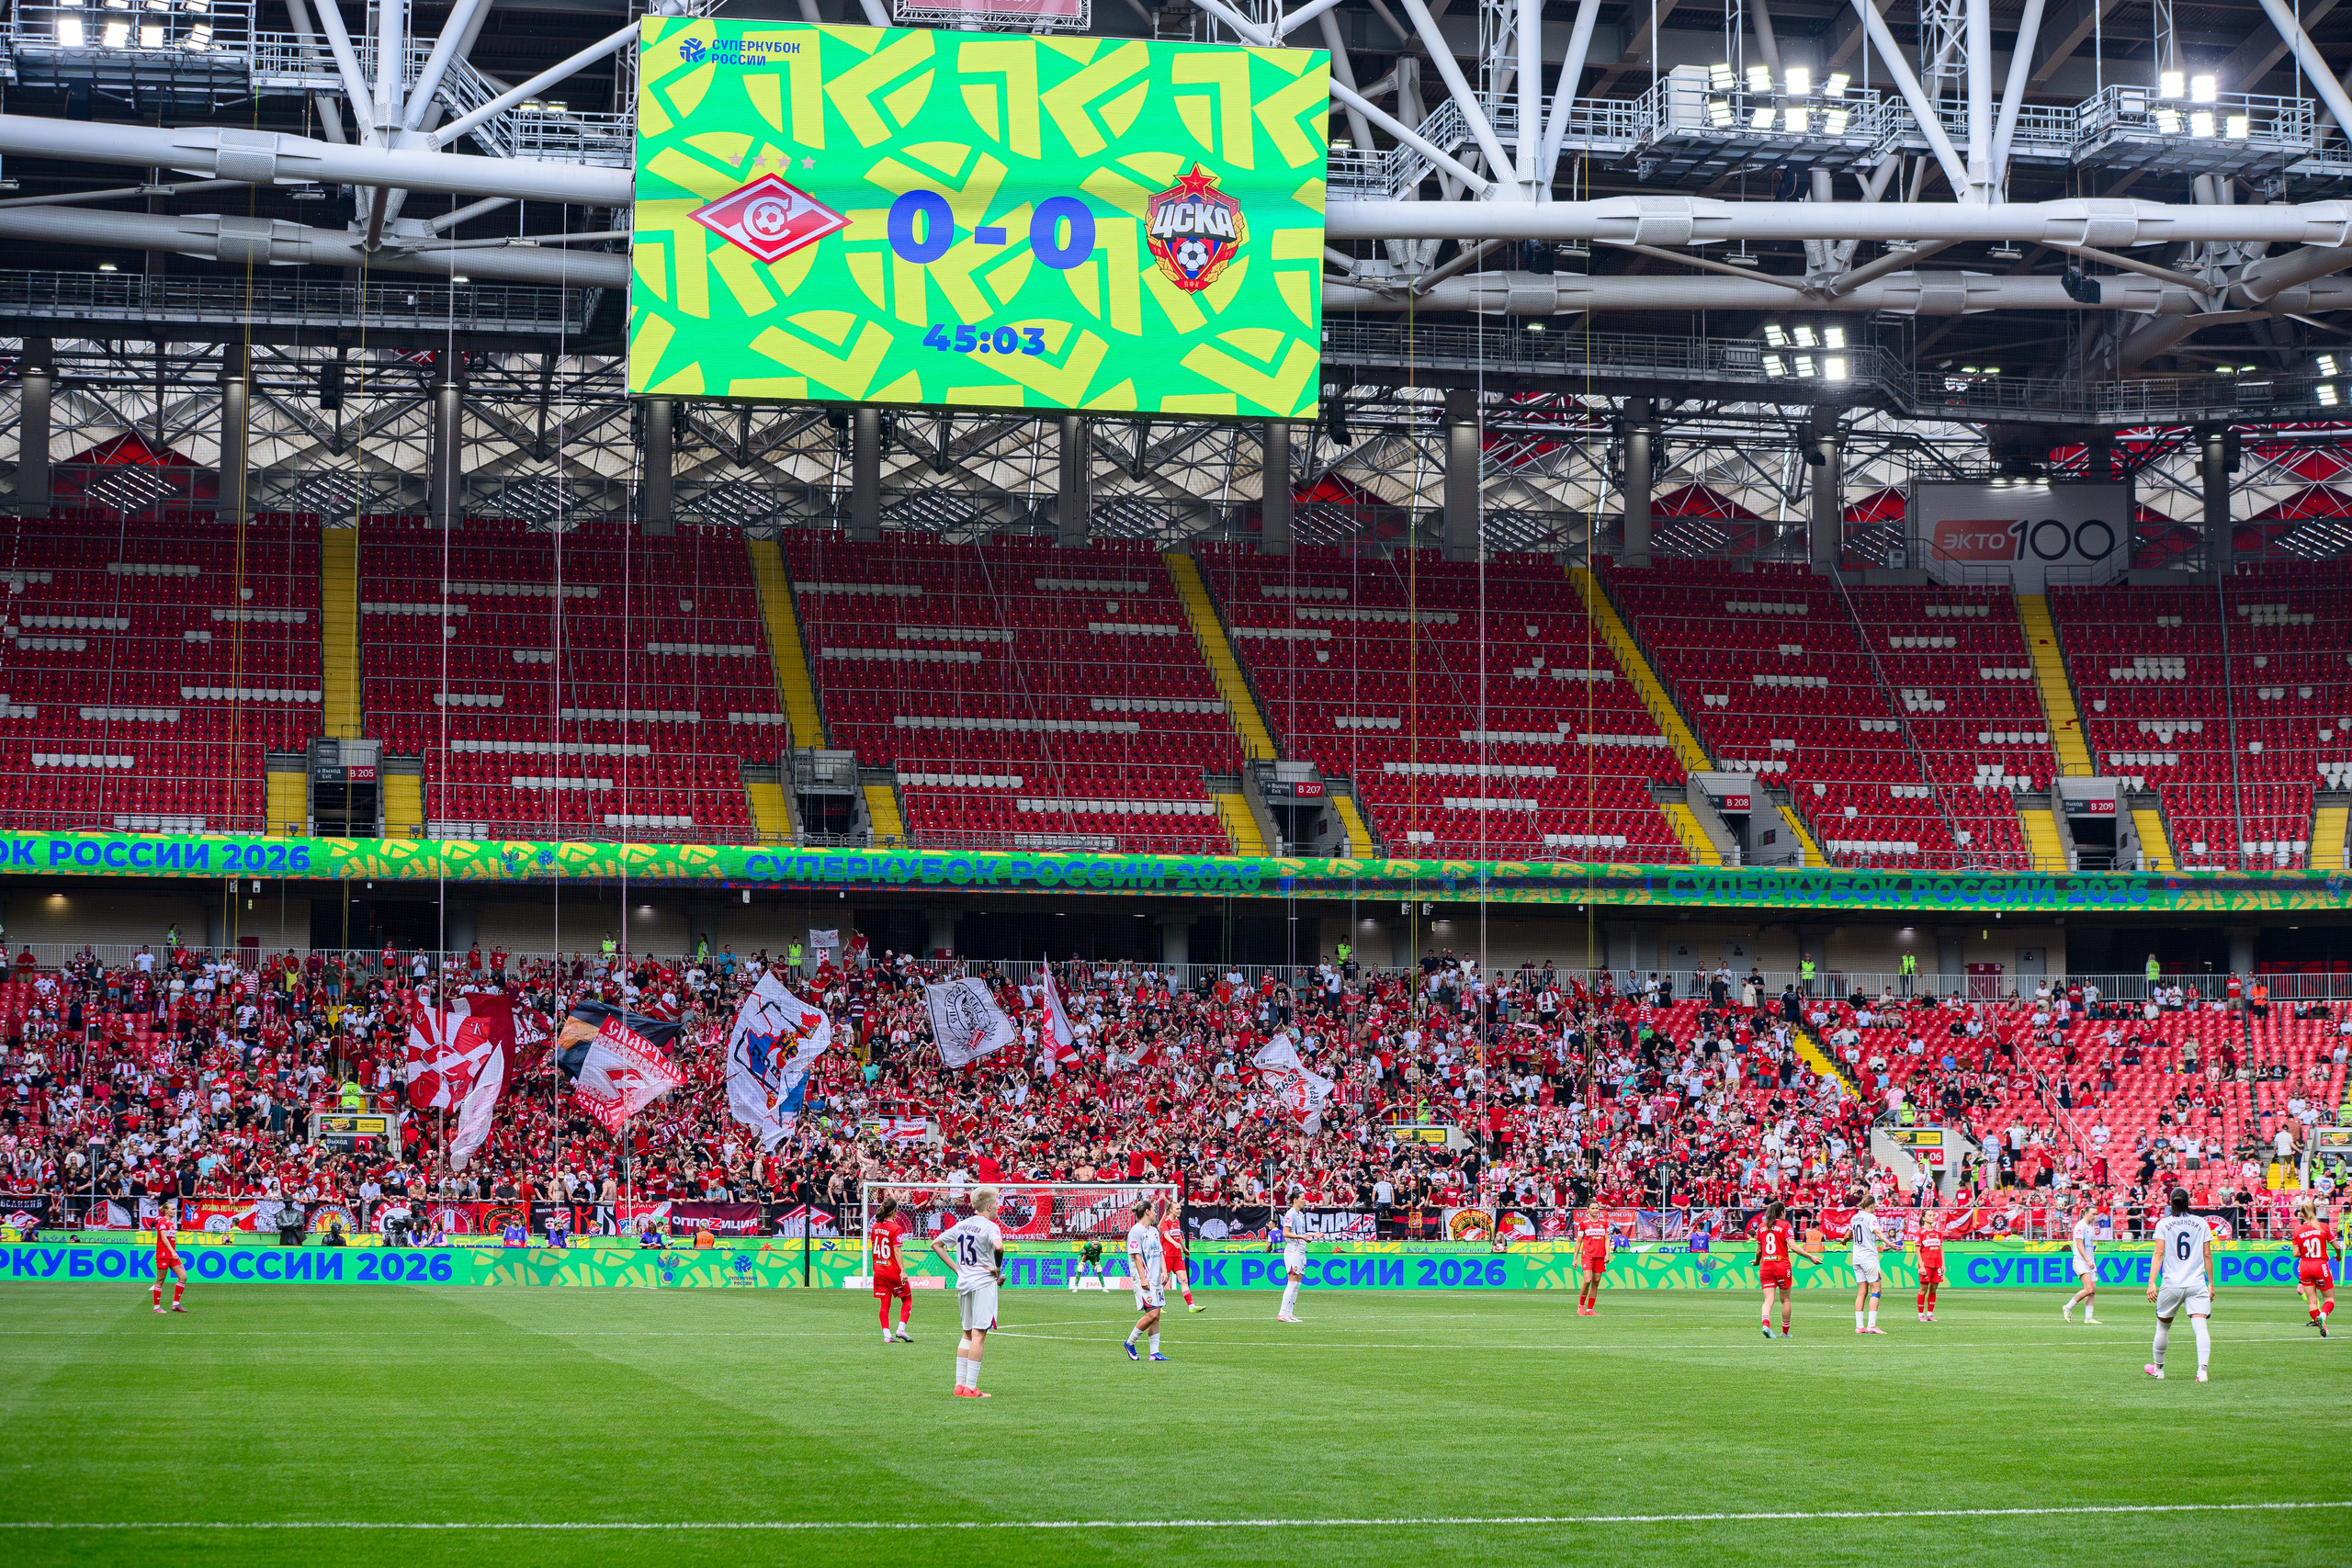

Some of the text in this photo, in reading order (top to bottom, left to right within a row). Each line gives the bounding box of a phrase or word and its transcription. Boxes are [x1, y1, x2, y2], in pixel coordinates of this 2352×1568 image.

[711, 39, 801, 53] СУПЕРКУБОК
[711, 53, 766, 66] РОССИИ
[888, 189, 955, 264] 0
[1029, 196, 1096, 269] 0
[1150, 202, 1238, 242] ЦСКА
[922, 323, 1046, 355] 45:03
[1942, 533, 2006, 549] ЭКТО
[2007, 519, 2116, 561] 100
[357, 769, 374, 777] 205
[1306, 785, 1321, 794] 207
[50, 840, 210, 869] РОССИИ
[221, 844, 311, 872] 2026
[745, 854, 1261, 890] СУПЕРКУБОК РОССИИ 2026
[1667, 873, 2150, 903] СУПЕРКУБОК РОССИИ 2026
[1306, 1212, 1377, 1232] СЛАВА
[1853, 1224, 1863, 1246] 10
[2165, 1219, 2203, 1232] ДАМЬЯНОВИЧ
[874, 1235, 891, 1259] 46
[957, 1234, 978, 1266] 13
[1765, 1232, 1777, 1255] 8
[2177, 1231, 2191, 1261] 6
[2302, 1237, 2322, 1258] 10
[170, 1249, 345, 1280] РОССИИ
[356, 1252, 453, 1281] 2026
[1417, 1258, 1507, 1287] 2026
